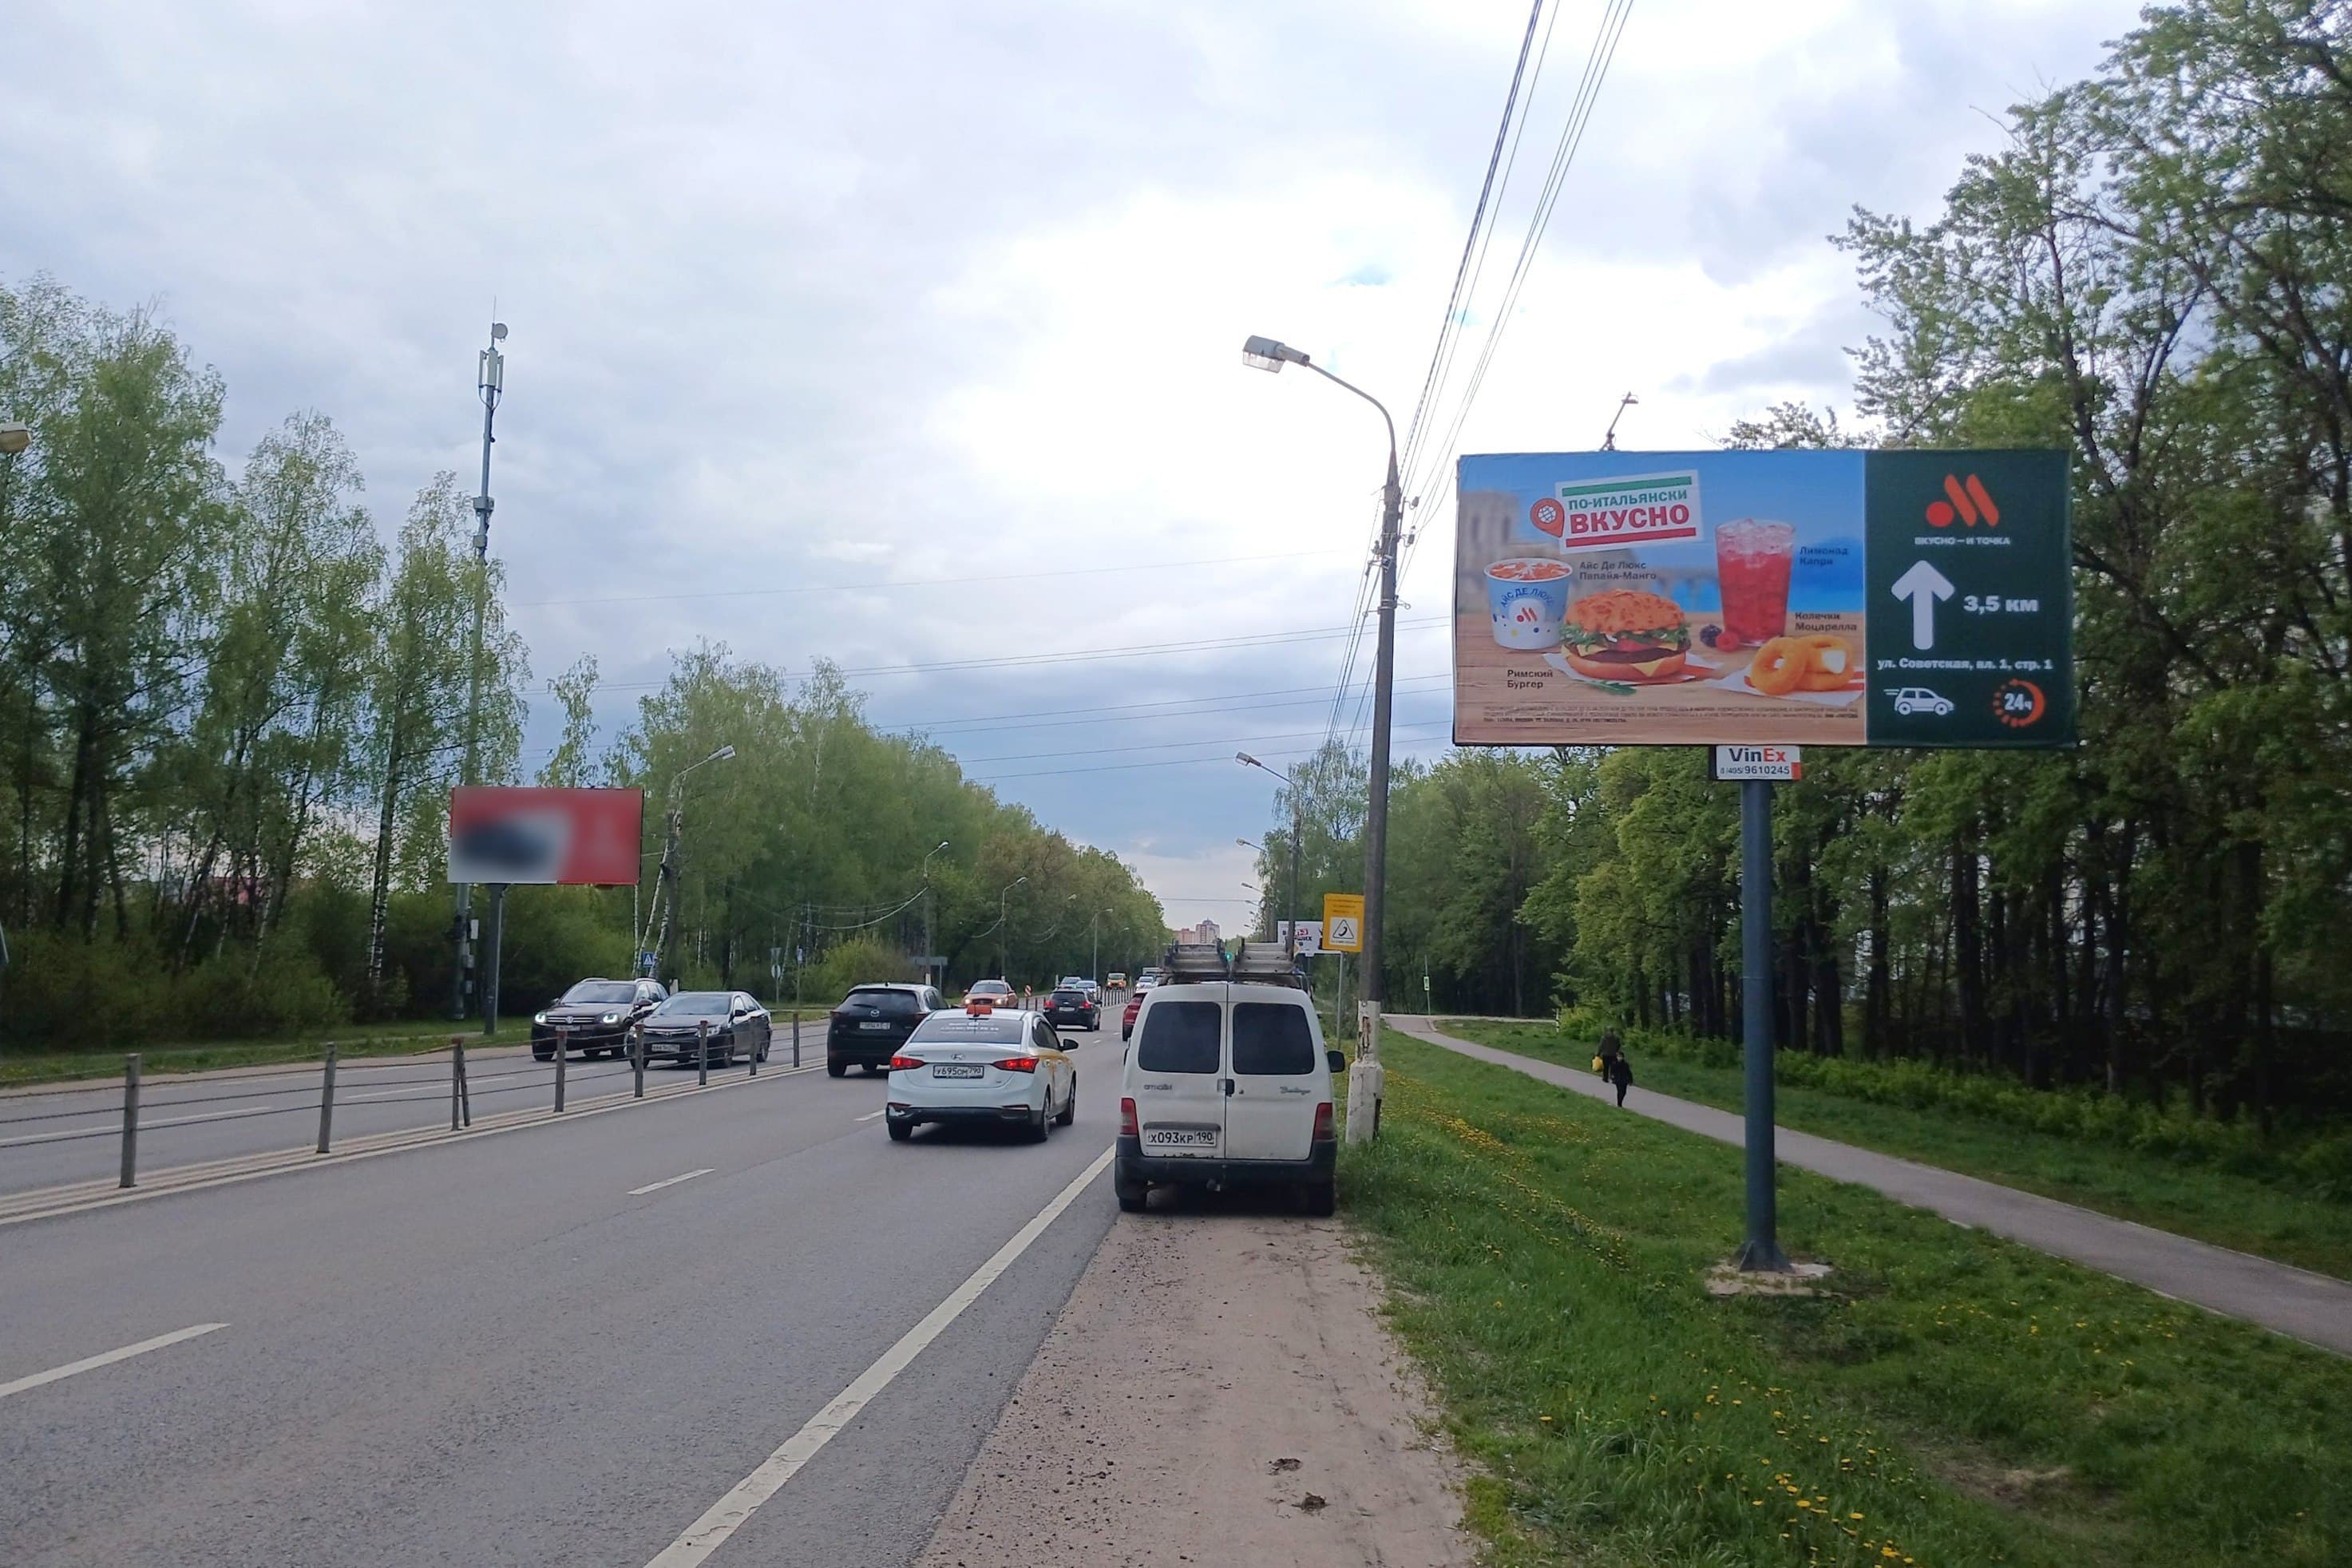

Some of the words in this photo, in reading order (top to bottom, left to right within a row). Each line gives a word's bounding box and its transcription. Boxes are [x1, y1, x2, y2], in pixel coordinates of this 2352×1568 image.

[1569, 489, 1688, 510] ПО-ИТАЛЬЯНСКИ
[1570, 504, 1689, 534] ВКУСНО
[1914, 537, 1955, 545] ВКУСНО
[1976, 537, 2011, 545] ТОЧКА
[1800, 546, 1850, 556] Лимонад
[1579, 560, 1598, 570] Айс
[1601, 561, 1617, 571] Де
[1617, 561, 1647, 570] Люкс
[1800, 557, 1834, 566] Капри
[1579, 572, 1657, 581] Папайя-Манго
[1963, 595, 2001, 615] 3,5
[1795, 623, 1857, 632] Моцарелла
[1877, 659, 1896, 671] ул.
[1899, 658, 1974, 671] Советская,
[2014, 660, 2041, 671] стр.
[2044, 659, 2053, 670] 1
[1507, 669, 1554, 678] Римский
[1507, 680, 1544, 690] Бургер
[1728, 747, 1787, 762] VinEx
